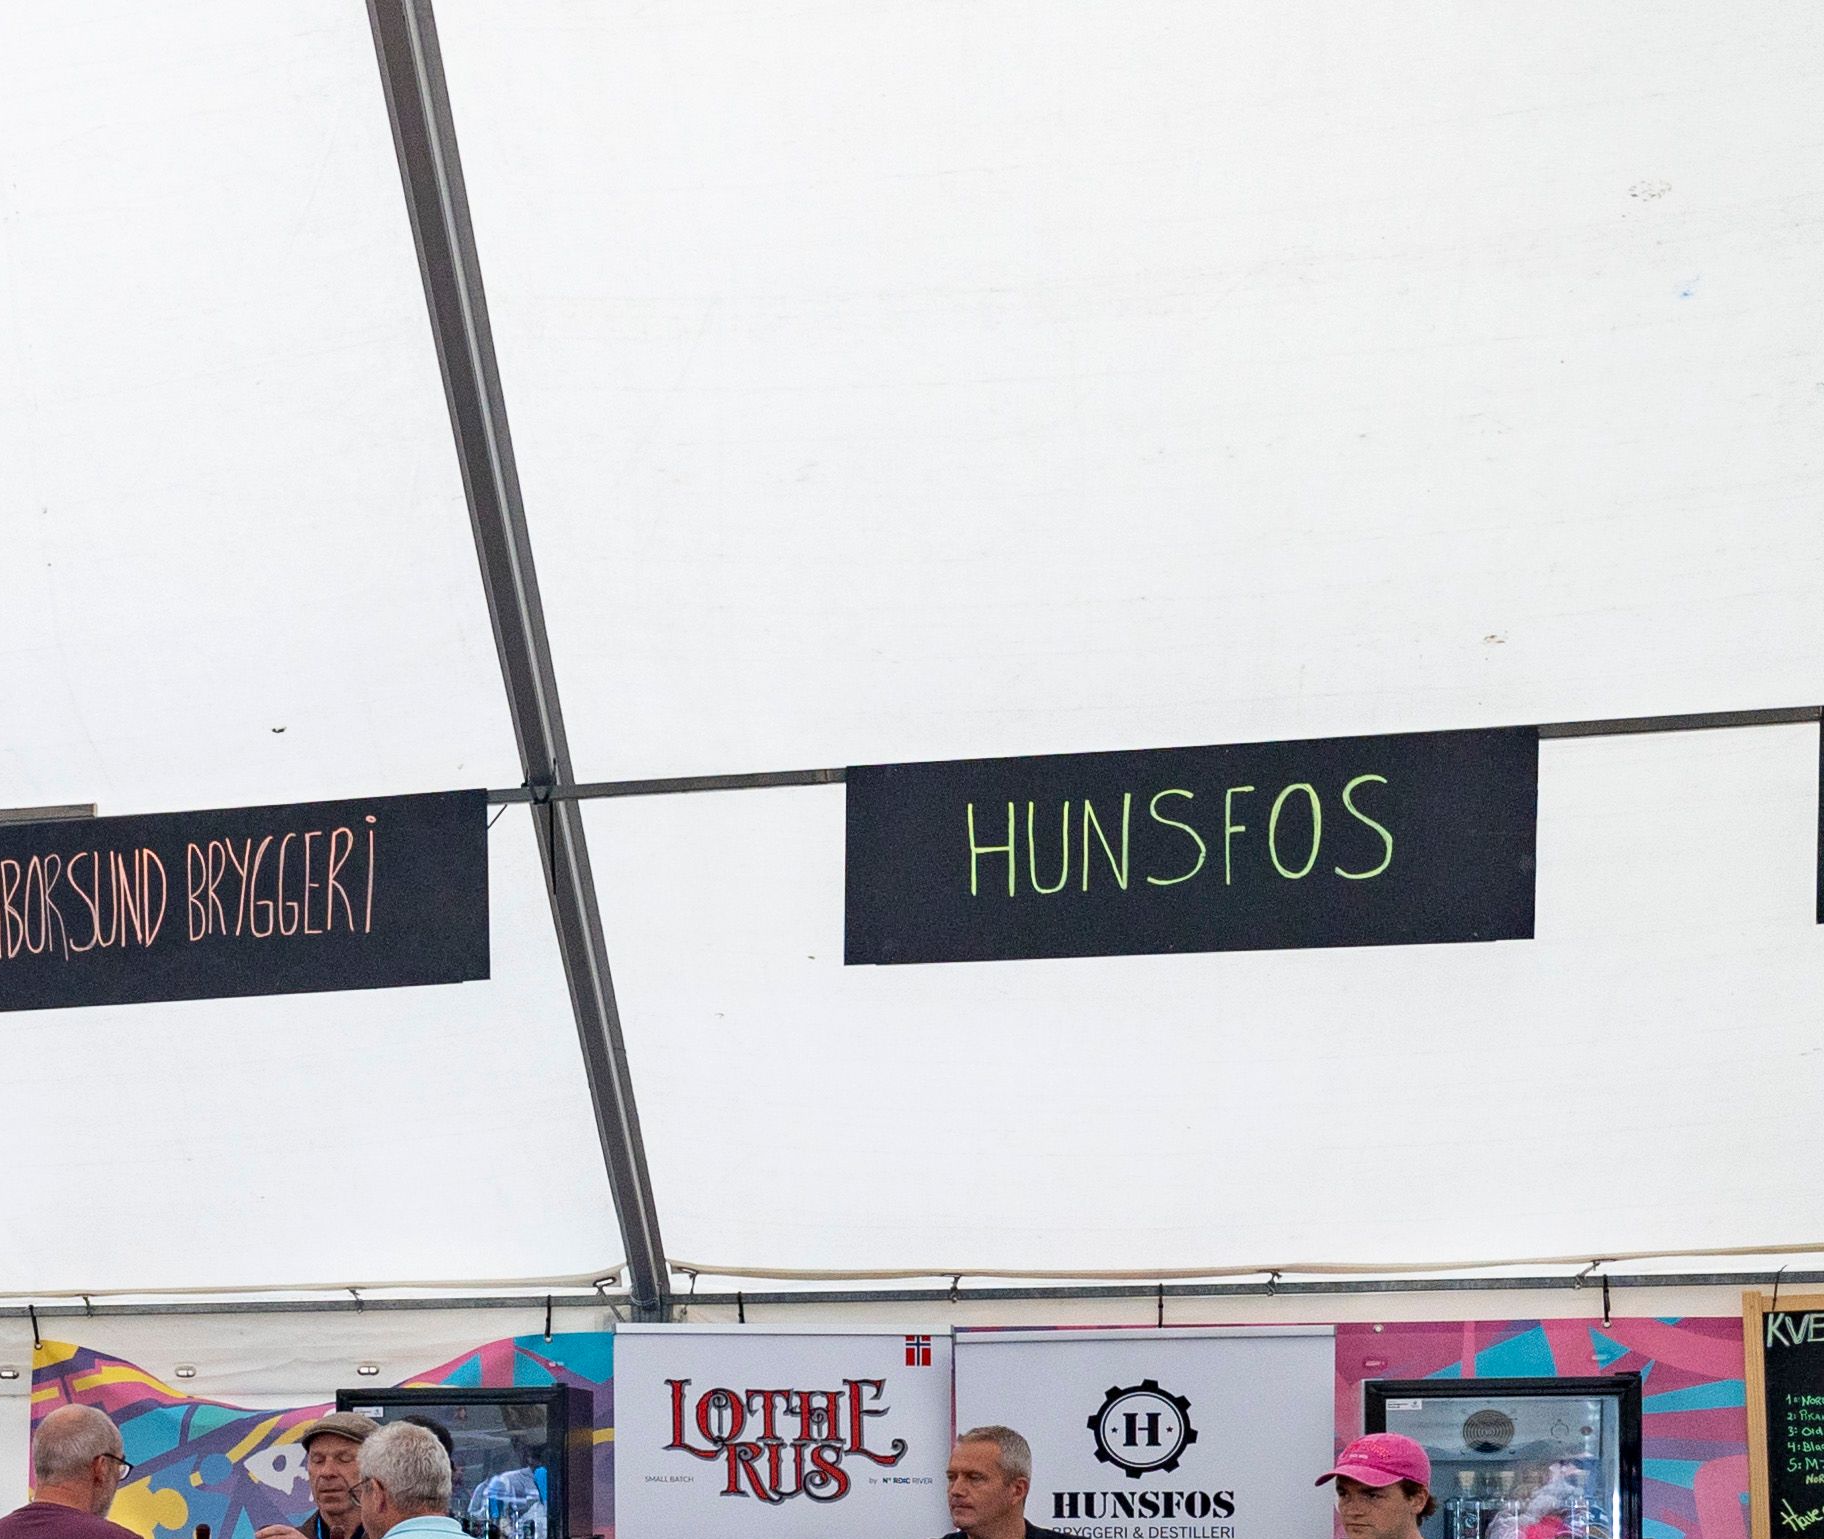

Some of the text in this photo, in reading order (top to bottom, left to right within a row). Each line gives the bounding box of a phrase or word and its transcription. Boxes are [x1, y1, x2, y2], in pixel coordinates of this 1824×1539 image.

[966, 773, 1395, 898] HUNSFOS
[662, 1378, 909, 1468] LOTHE
[720, 1441, 853, 1505] RUS
[1052, 1490, 1236, 1520] HUNSFOS
[1132, 1526, 1144, 1539] &
[1148, 1527, 1235, 1539] DESTILLERI
